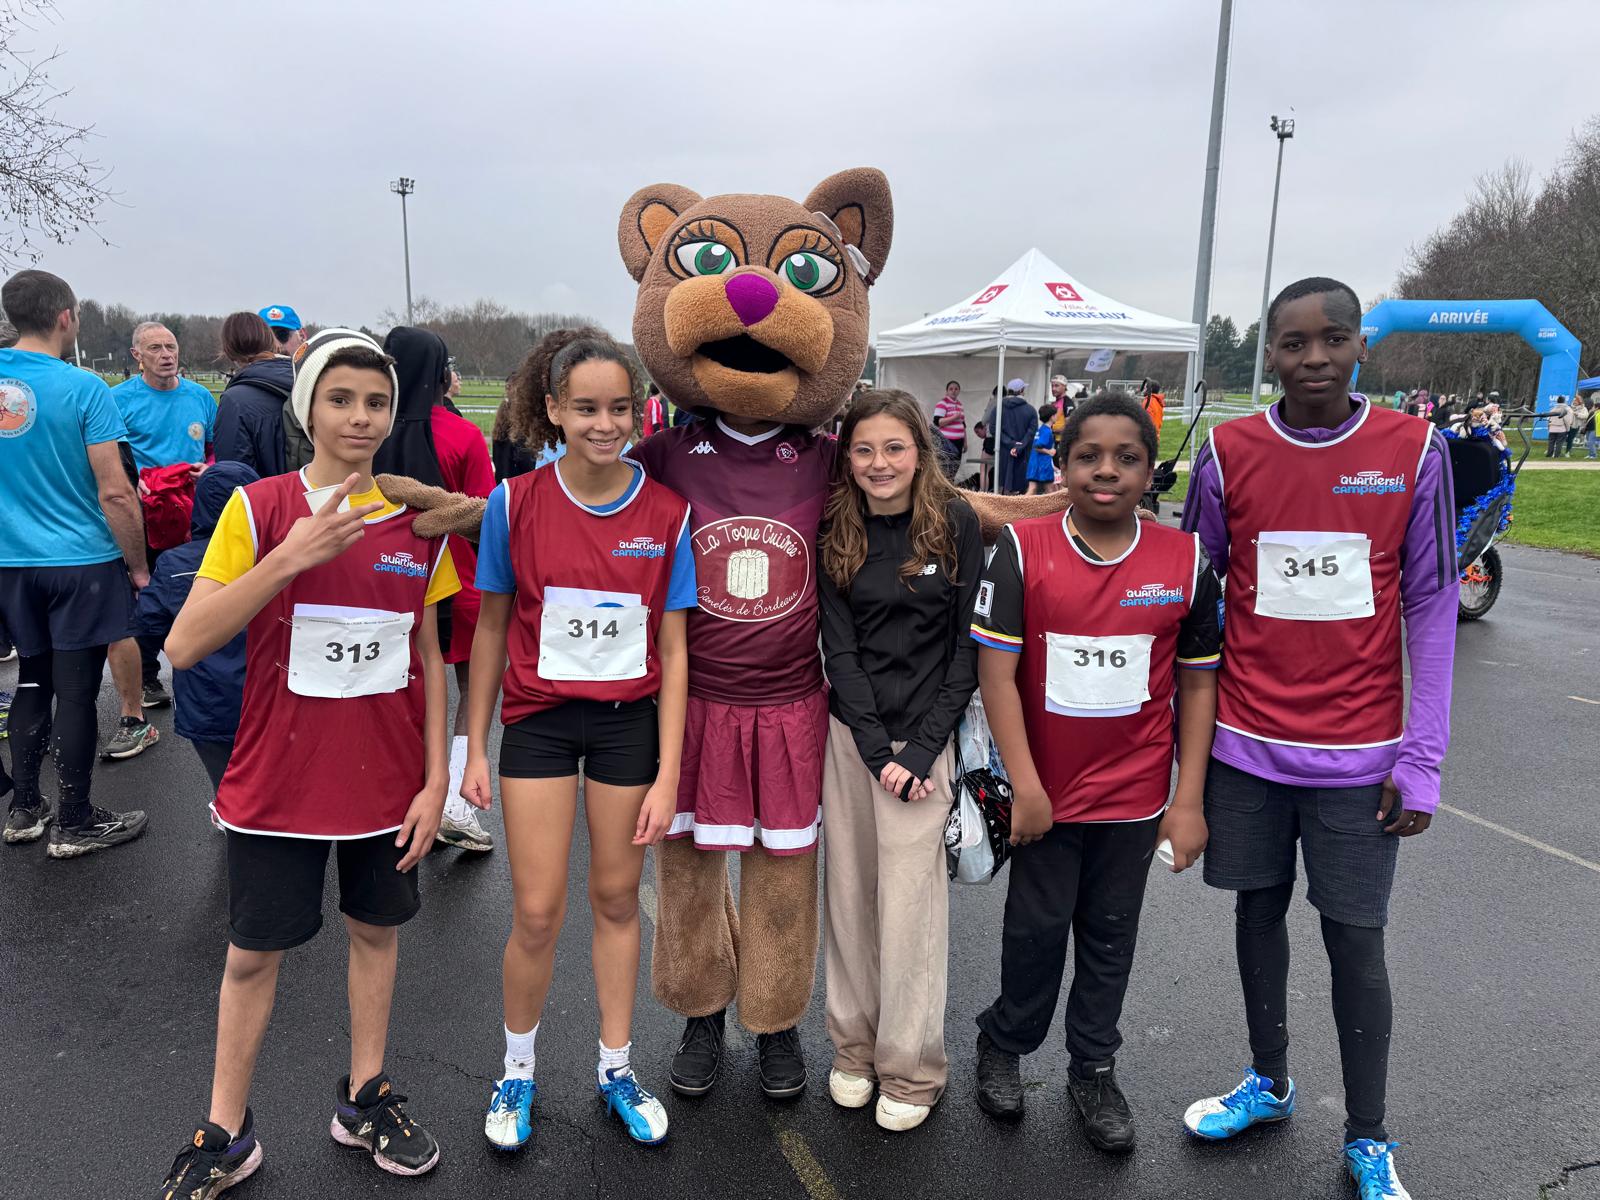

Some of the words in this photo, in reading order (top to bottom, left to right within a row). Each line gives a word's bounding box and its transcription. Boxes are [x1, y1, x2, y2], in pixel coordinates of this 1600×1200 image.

[1044, 310, 1133, 320] BORDEAUX
[1428, 309, 1489, 324] ARRIVÉE
[696, 538, 720, 555] La
[717, 523, 760, 547] Toque
[1284, 555, 1339, 577] 315
[697, 586, 734, 613] Canelés
[736, 603, 750, 615] de
[753, 591, 799, 616] Bordeaux
[568, 619, 619, 639] 314
[325, 641, 380, 663] 313
[1073, 649, 1127, 668] 316
